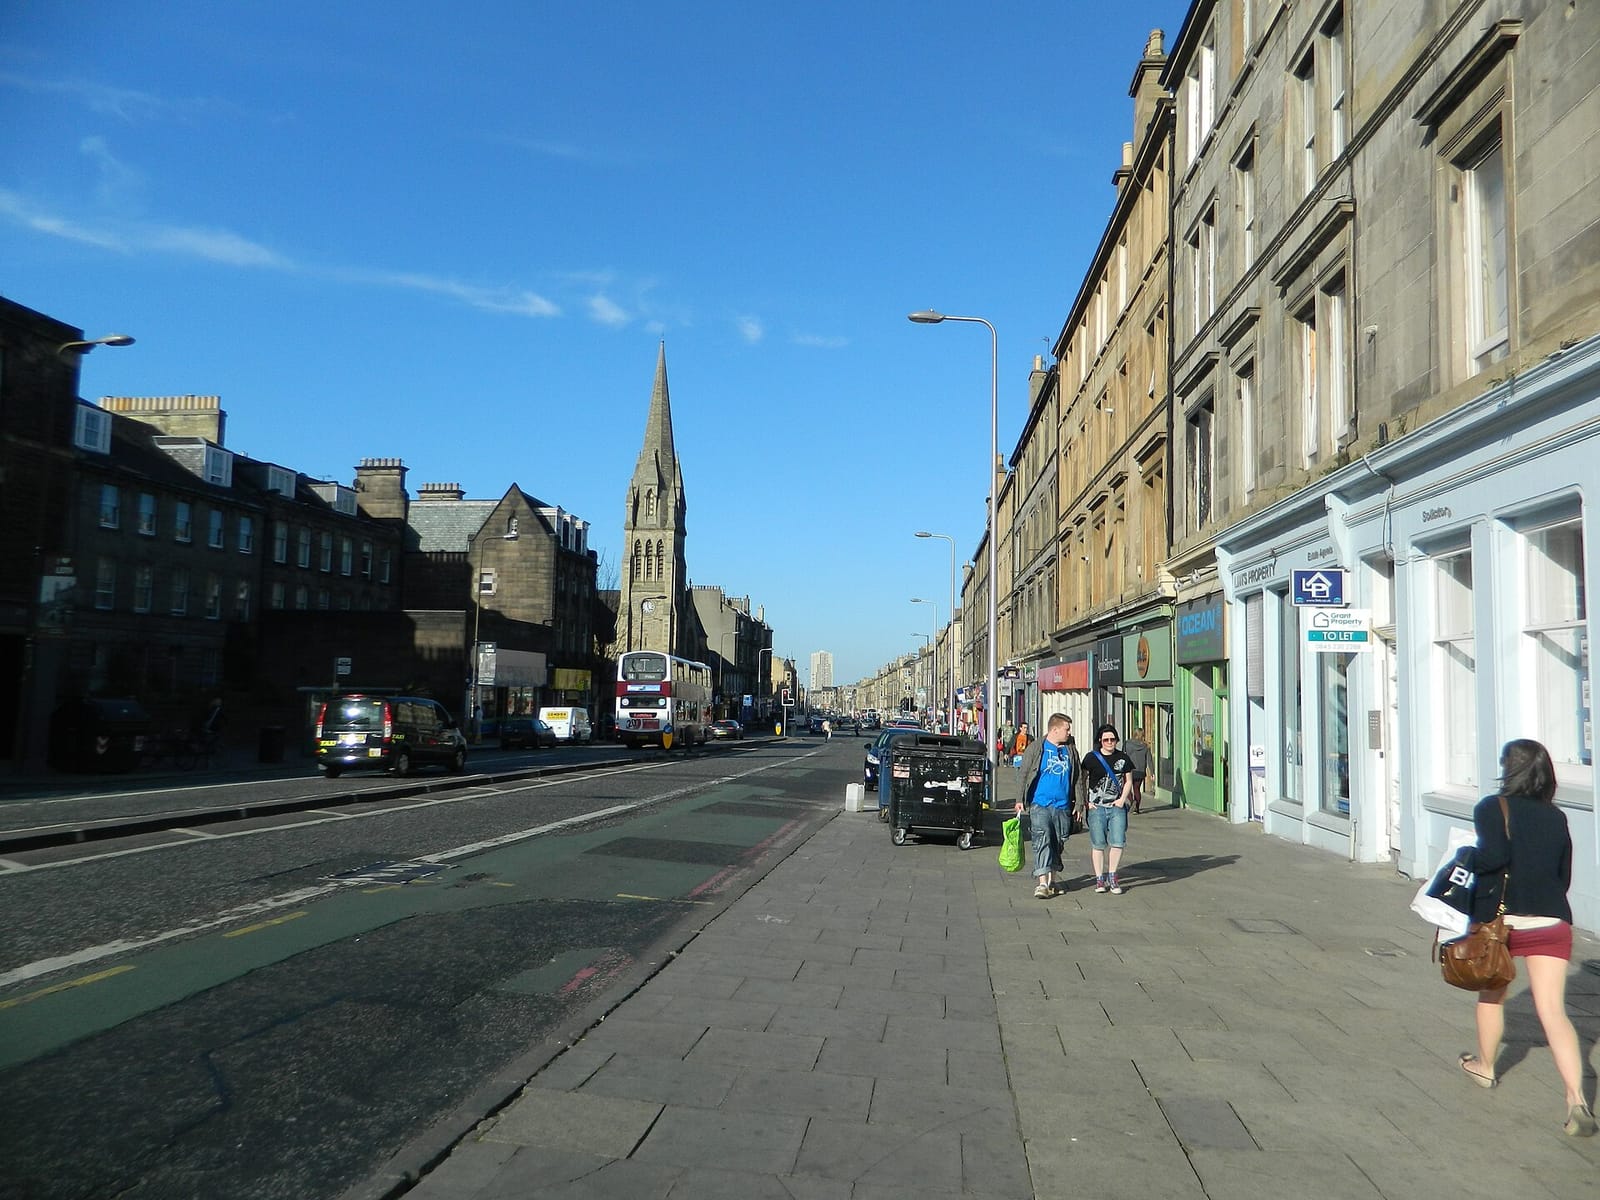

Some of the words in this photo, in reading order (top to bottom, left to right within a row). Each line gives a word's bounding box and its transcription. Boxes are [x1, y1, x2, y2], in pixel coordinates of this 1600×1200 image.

[1248, 561, 1275, 584] PROPERTY
[1181, 609, 1215, 636] OCEAN
[1330, 618, 1362, 626] Property
[1322, 632, 1337, 641] TO
[1339, 632, 1354, 641] LET
